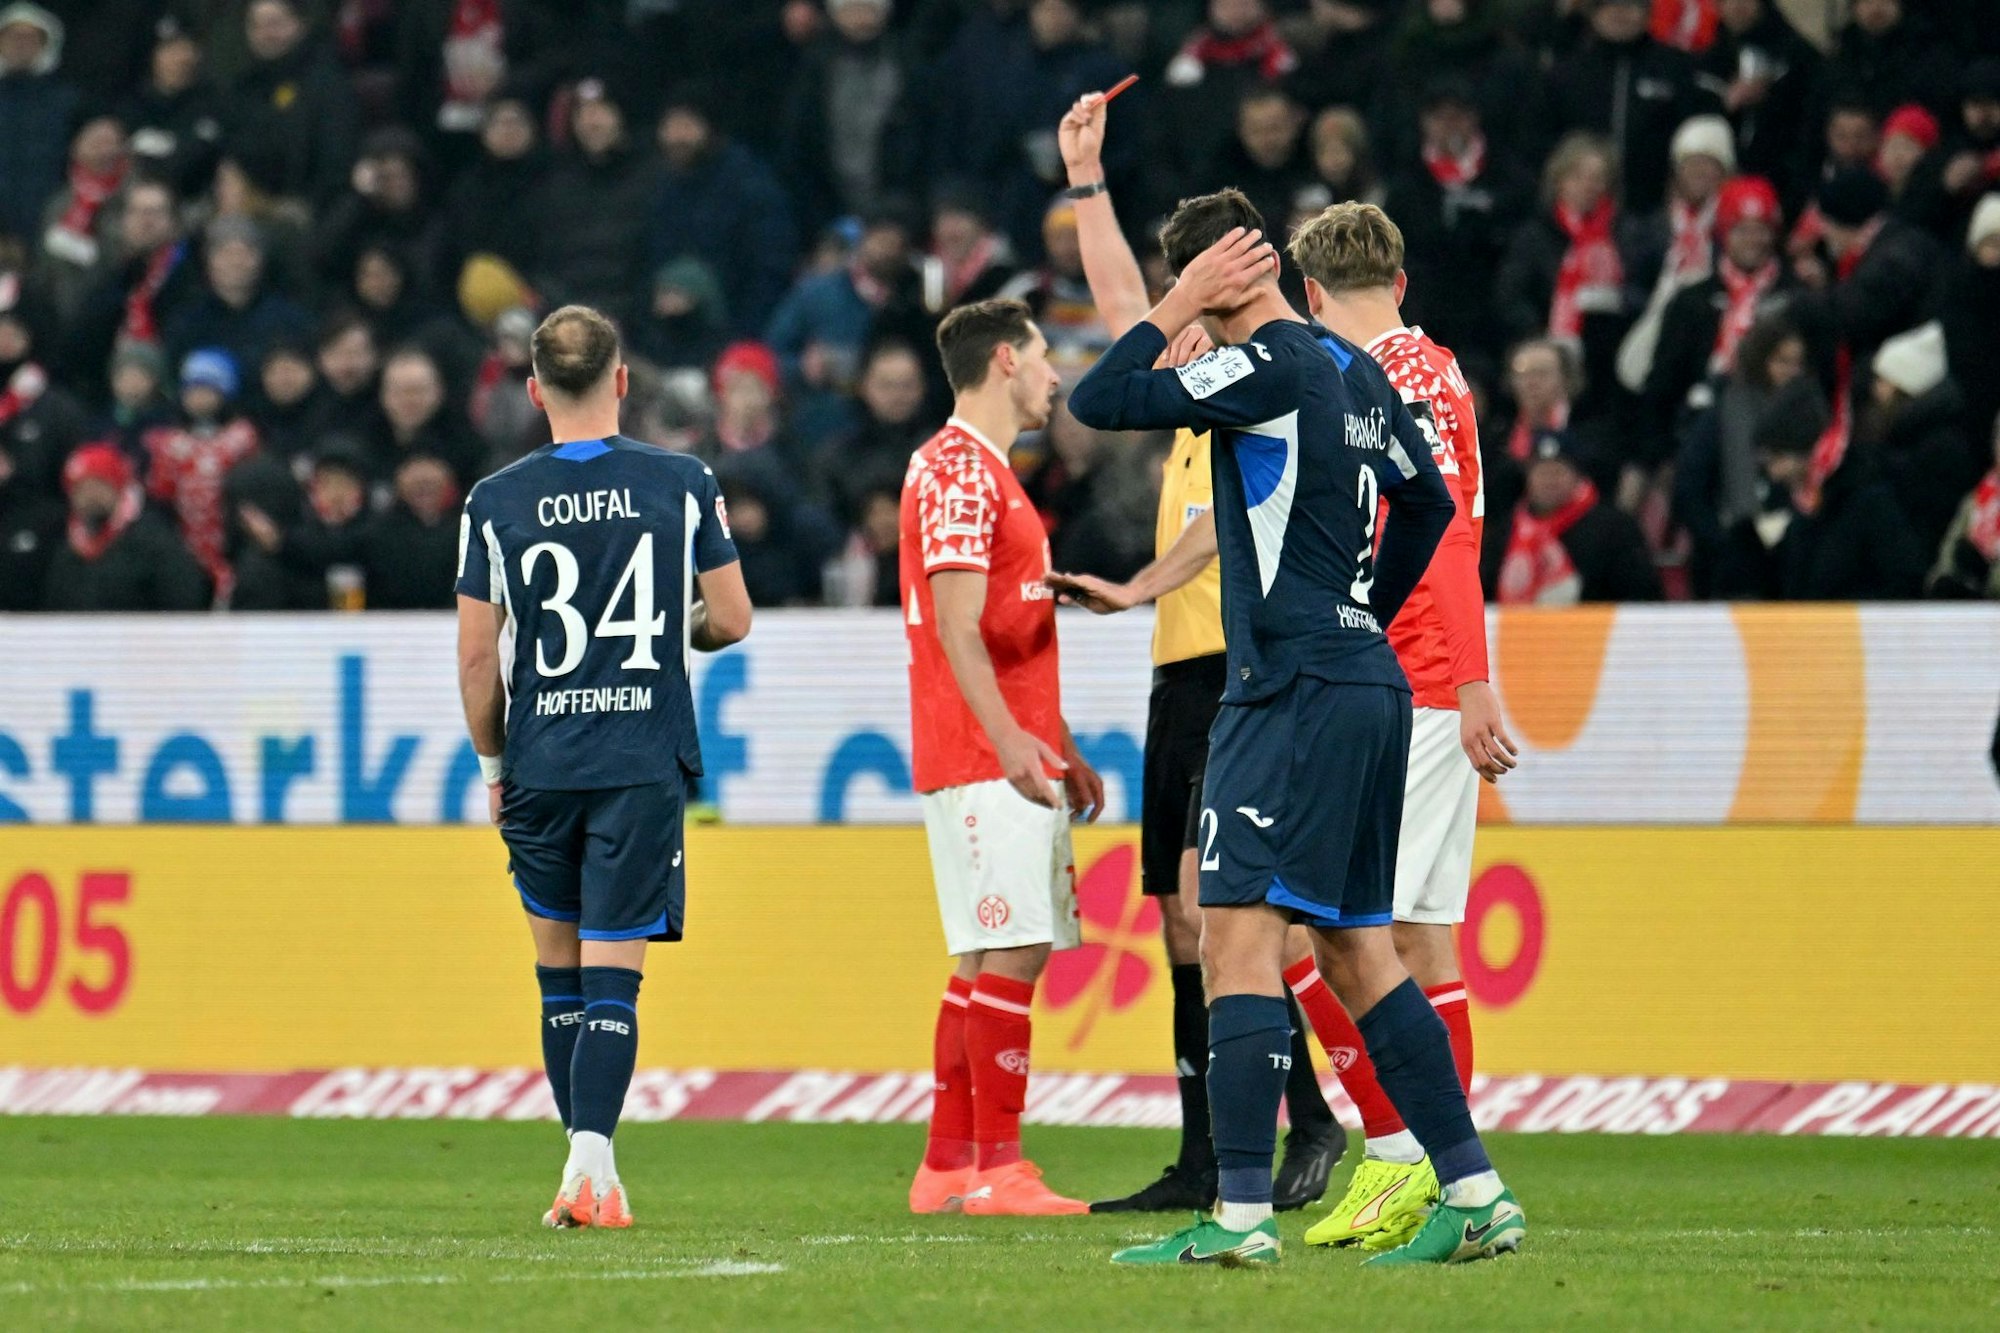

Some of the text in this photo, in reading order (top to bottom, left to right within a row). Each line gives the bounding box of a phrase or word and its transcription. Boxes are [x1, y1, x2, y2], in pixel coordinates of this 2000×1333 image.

[1344, 407, 1387, 450] HRANÁČ
[538, 488, 640, 527] COUFAL
[1349, 463, 1379, 605] 2
[520, 532, 667, 678] 34
[536, 686, 653, 717] HOFFENHEIM
[1200, 807, 1221, 872] 2
[588, 1019, 631, 1037] TSG
[1515, 1074, 1729, 1136] DOGS
